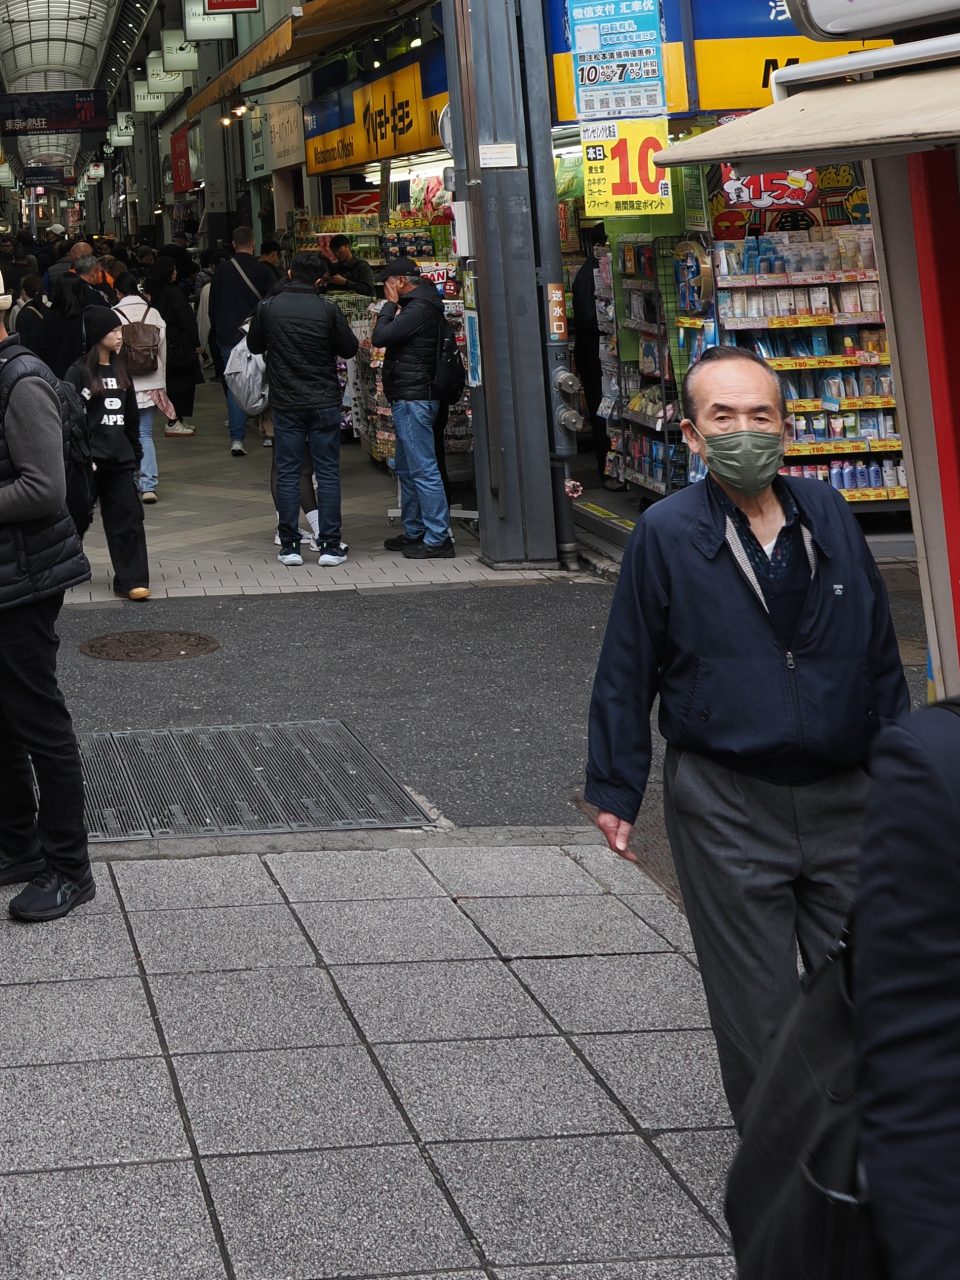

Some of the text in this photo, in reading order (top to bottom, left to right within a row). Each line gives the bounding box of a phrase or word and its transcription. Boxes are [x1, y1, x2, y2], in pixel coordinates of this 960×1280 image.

[572, 4, 615, 19] 微信支付
[586, 146, 604, 160] 本日
[588, 165, 605, 174] 資生堂
[610, 136, 666, 195] 10
[587, 177, 606, 186] カネボウ
[660, 182, 669, 197] 倍
[614, 199, 665, 211] 期間限定ポイント
[552, 289, 565, 333] 送水口
[100, 414, 125, 426] APE
